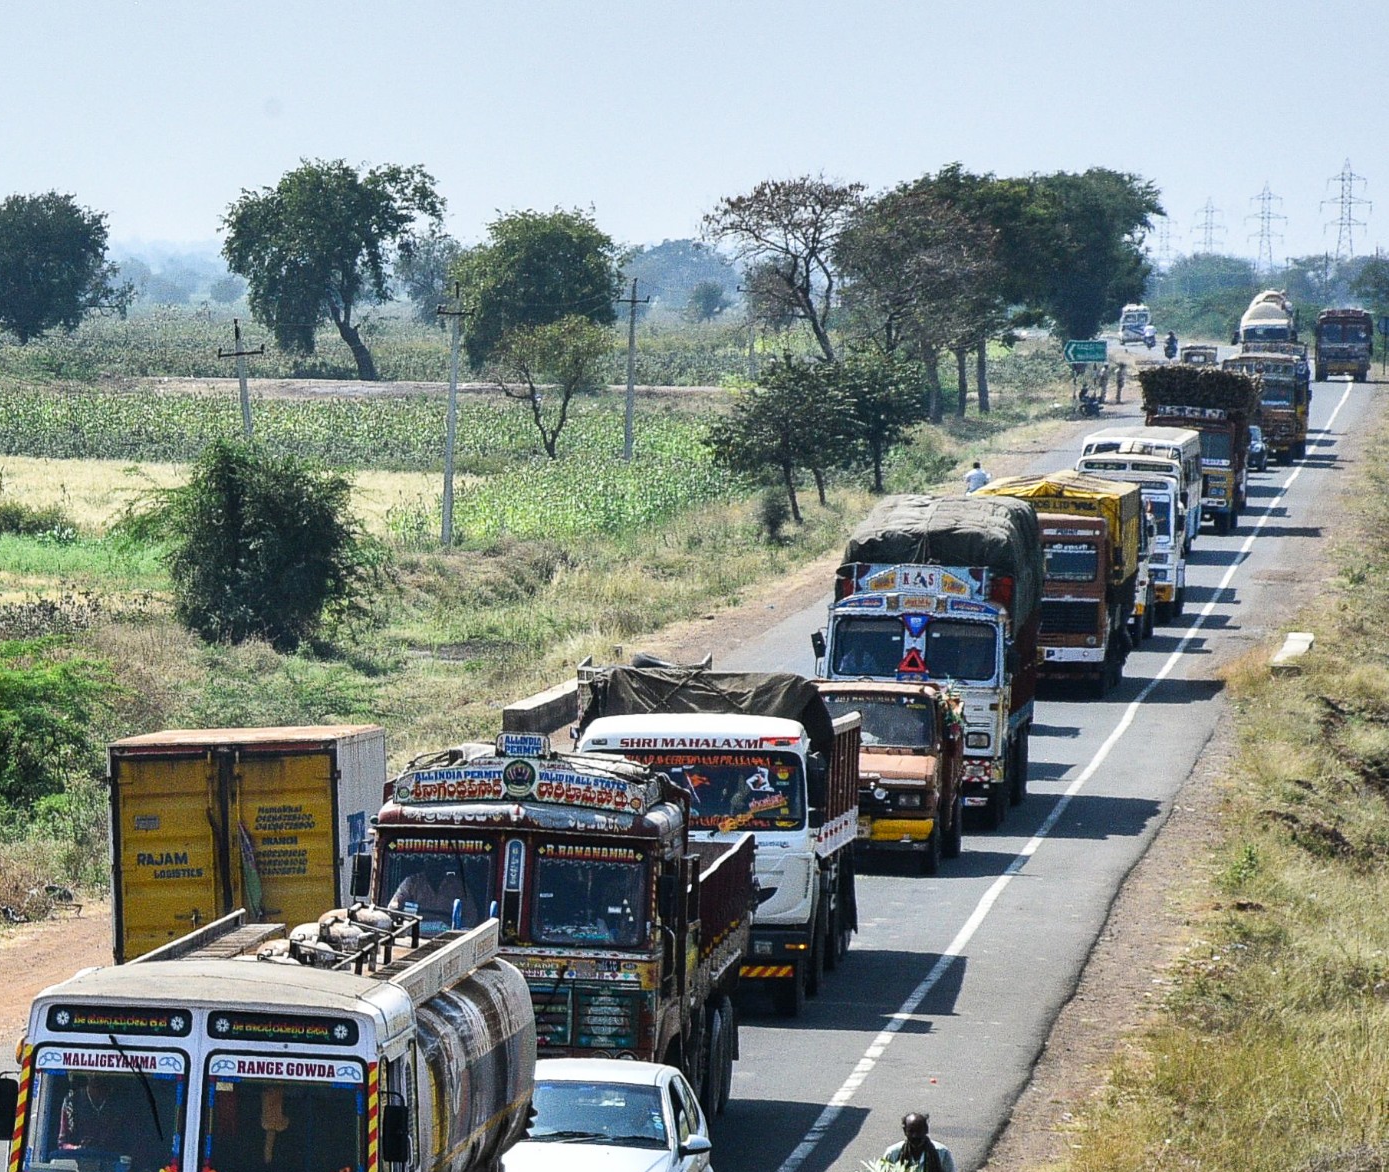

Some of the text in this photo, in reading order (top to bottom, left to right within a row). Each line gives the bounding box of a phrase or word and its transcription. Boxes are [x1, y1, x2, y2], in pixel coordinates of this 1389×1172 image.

[619, 737, 764, 749] SHRI MAHALAXMI
[505, 745, 542, 754] PERMIT
[435, 771, 462, 780] INDIA
[463, 769, 503, 780] PERMIT
[593, 779, 628, 790] STATES
[137, 852, 189, 867] RAJAM
[154, 868, 203, 879] LOGISTICS
[236, 1059, 336, 1079] RANGE GOWDA
